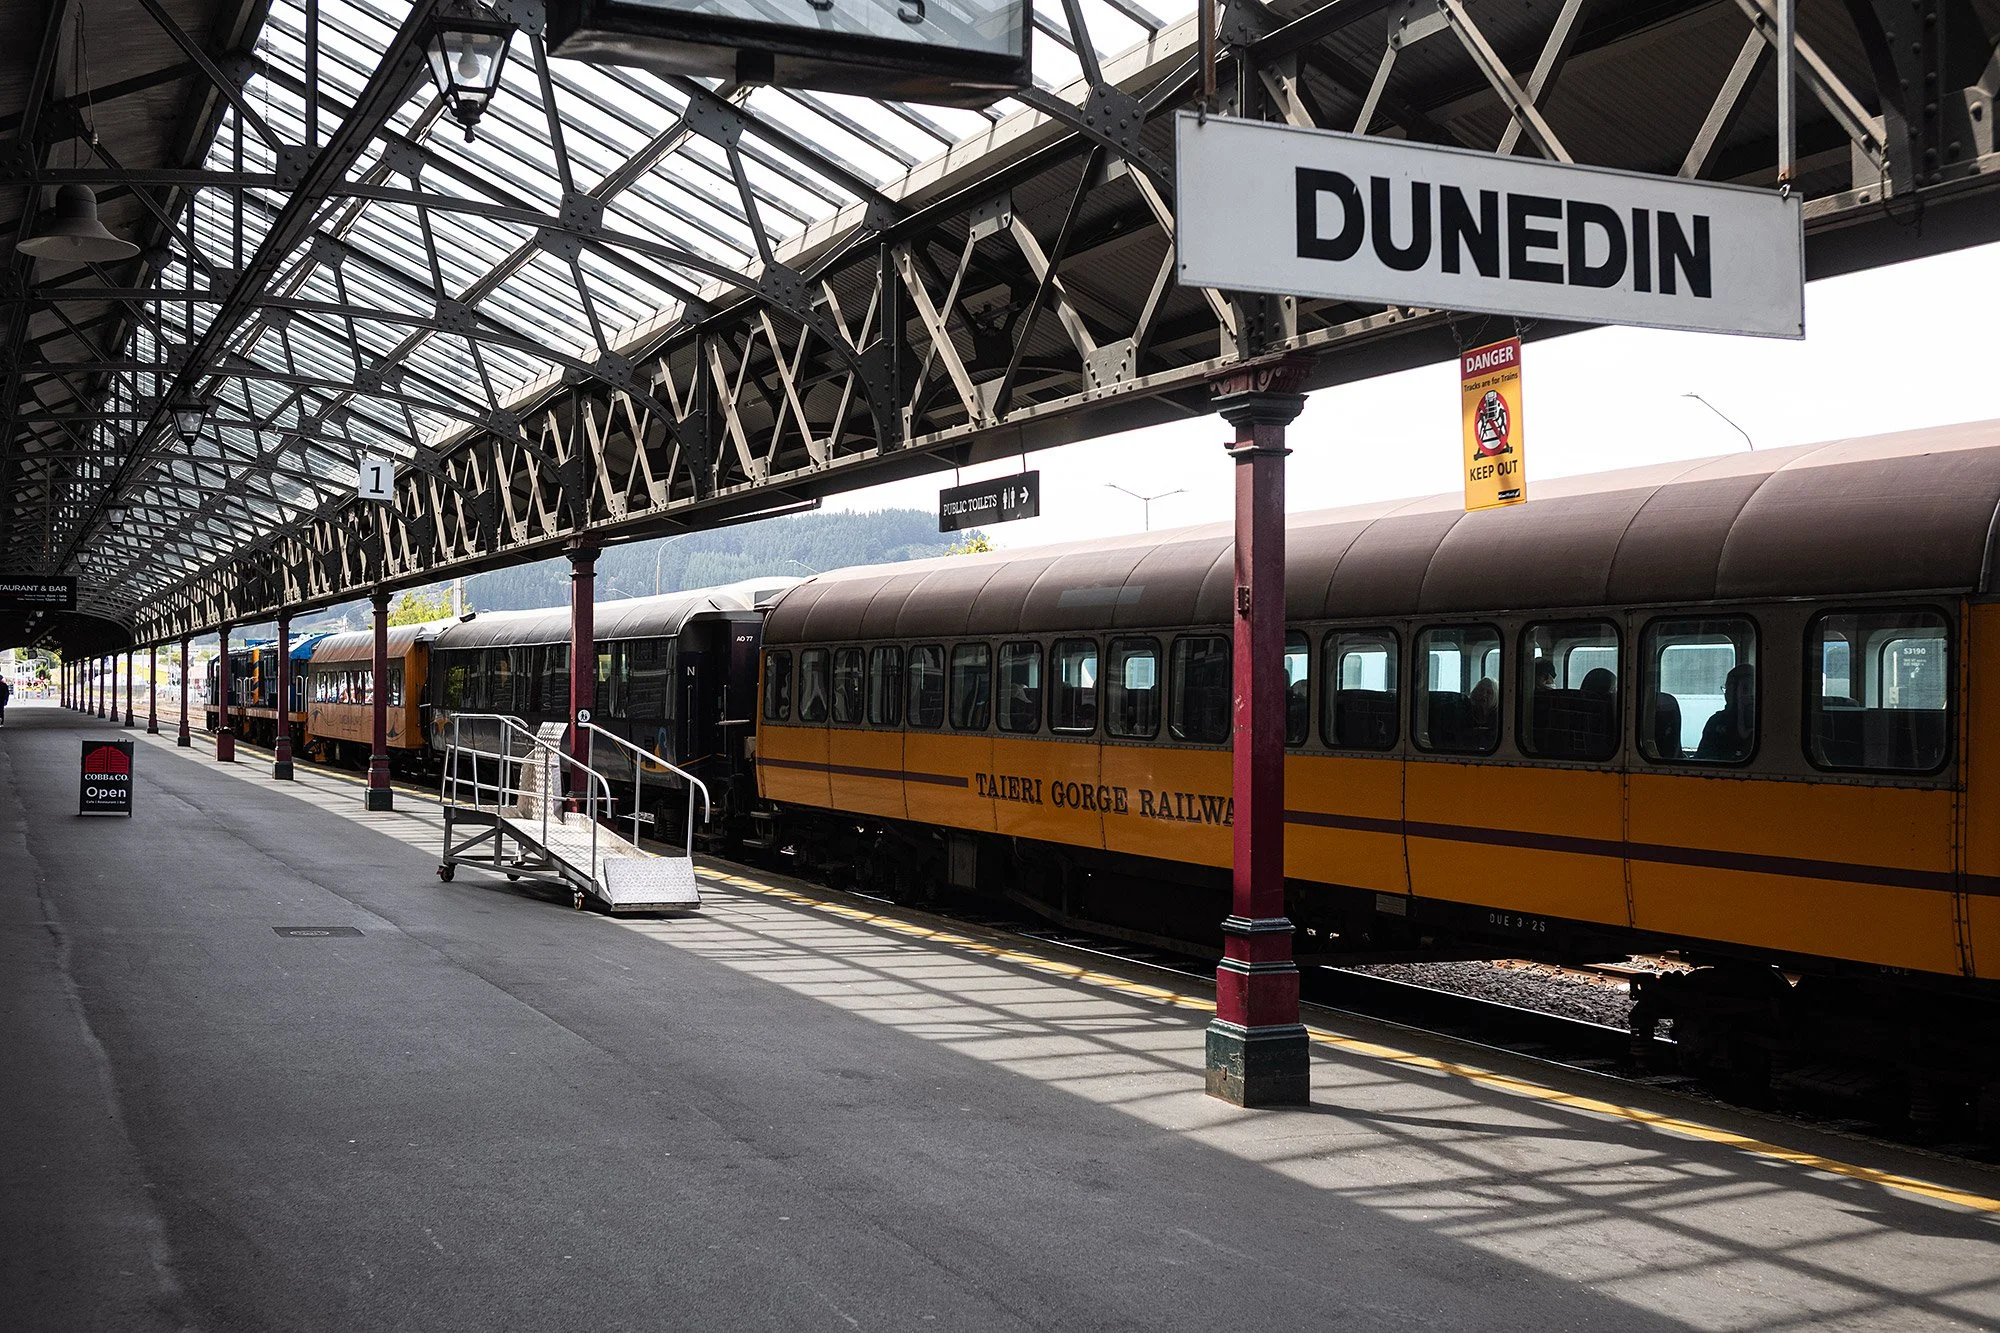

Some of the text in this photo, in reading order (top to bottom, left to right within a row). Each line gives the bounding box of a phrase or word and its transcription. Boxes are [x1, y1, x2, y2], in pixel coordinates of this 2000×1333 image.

[1295, 165, 1712, 299] DUNEDIN
[1466, 345, 1514, 373] DANGER
[1463, 382, 1481, 392] Tracks
[1491, 376, 1500, 385] for
[1501, 372, 1518, 382] Trains
[370, 466, 384, 494] 1
[1470, 460, 1518, 481] KEEP OUT
[943, 494, 997, 516] PUBLIC TOILETS
[0, 584, 38, 592] TAURANT
[687, 666, 695, 676] N
[86, 786, 126, 799] Open
[975, 772, 1234, 827] TAIERI GORGE RAILWA
